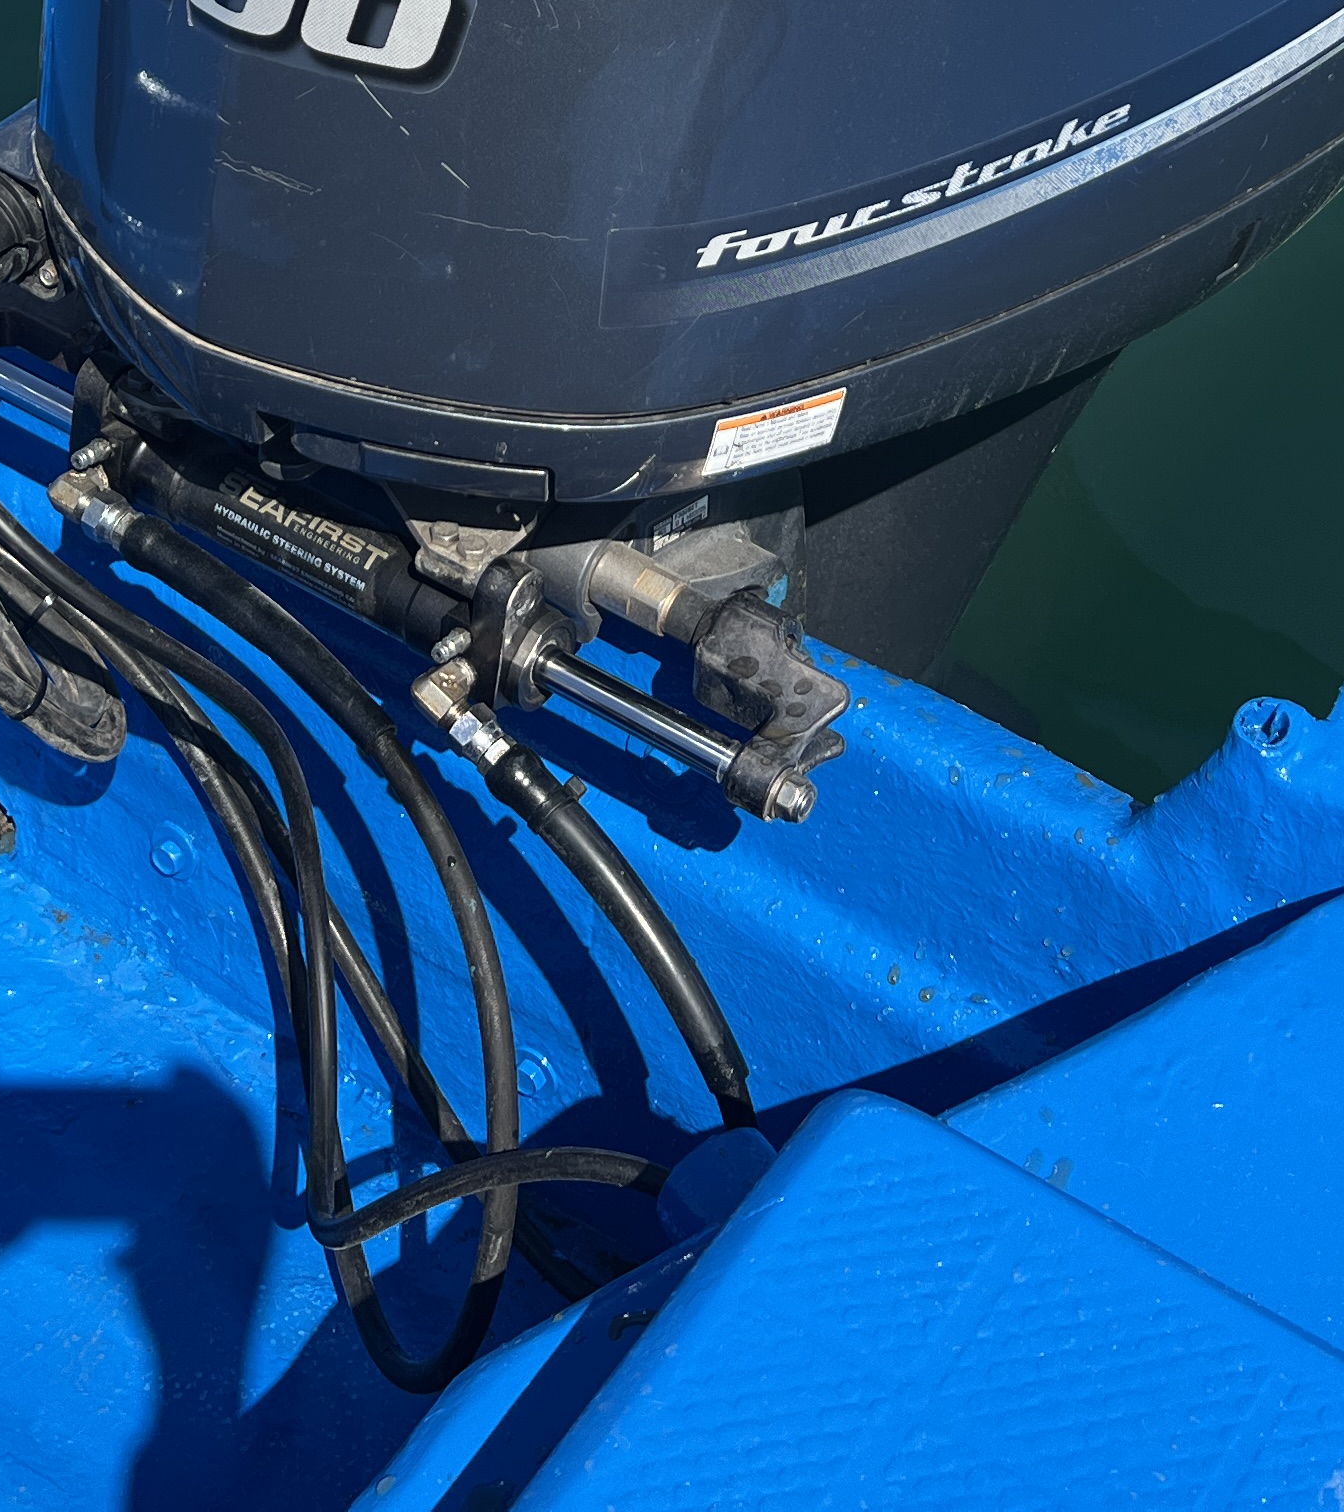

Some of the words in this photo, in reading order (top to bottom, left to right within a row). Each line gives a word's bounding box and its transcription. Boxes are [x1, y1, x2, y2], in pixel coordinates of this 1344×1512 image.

[696, 200, 896, 269] four
[901, 103, 1131, 207] stroke
[213, 503, 271, 544] HYDRAULIC
[272, 534, 323, 569] STEERING
[324, 562, 366, 592] SYSTEM
[292, 524, 362, 566] ENGINEERING
